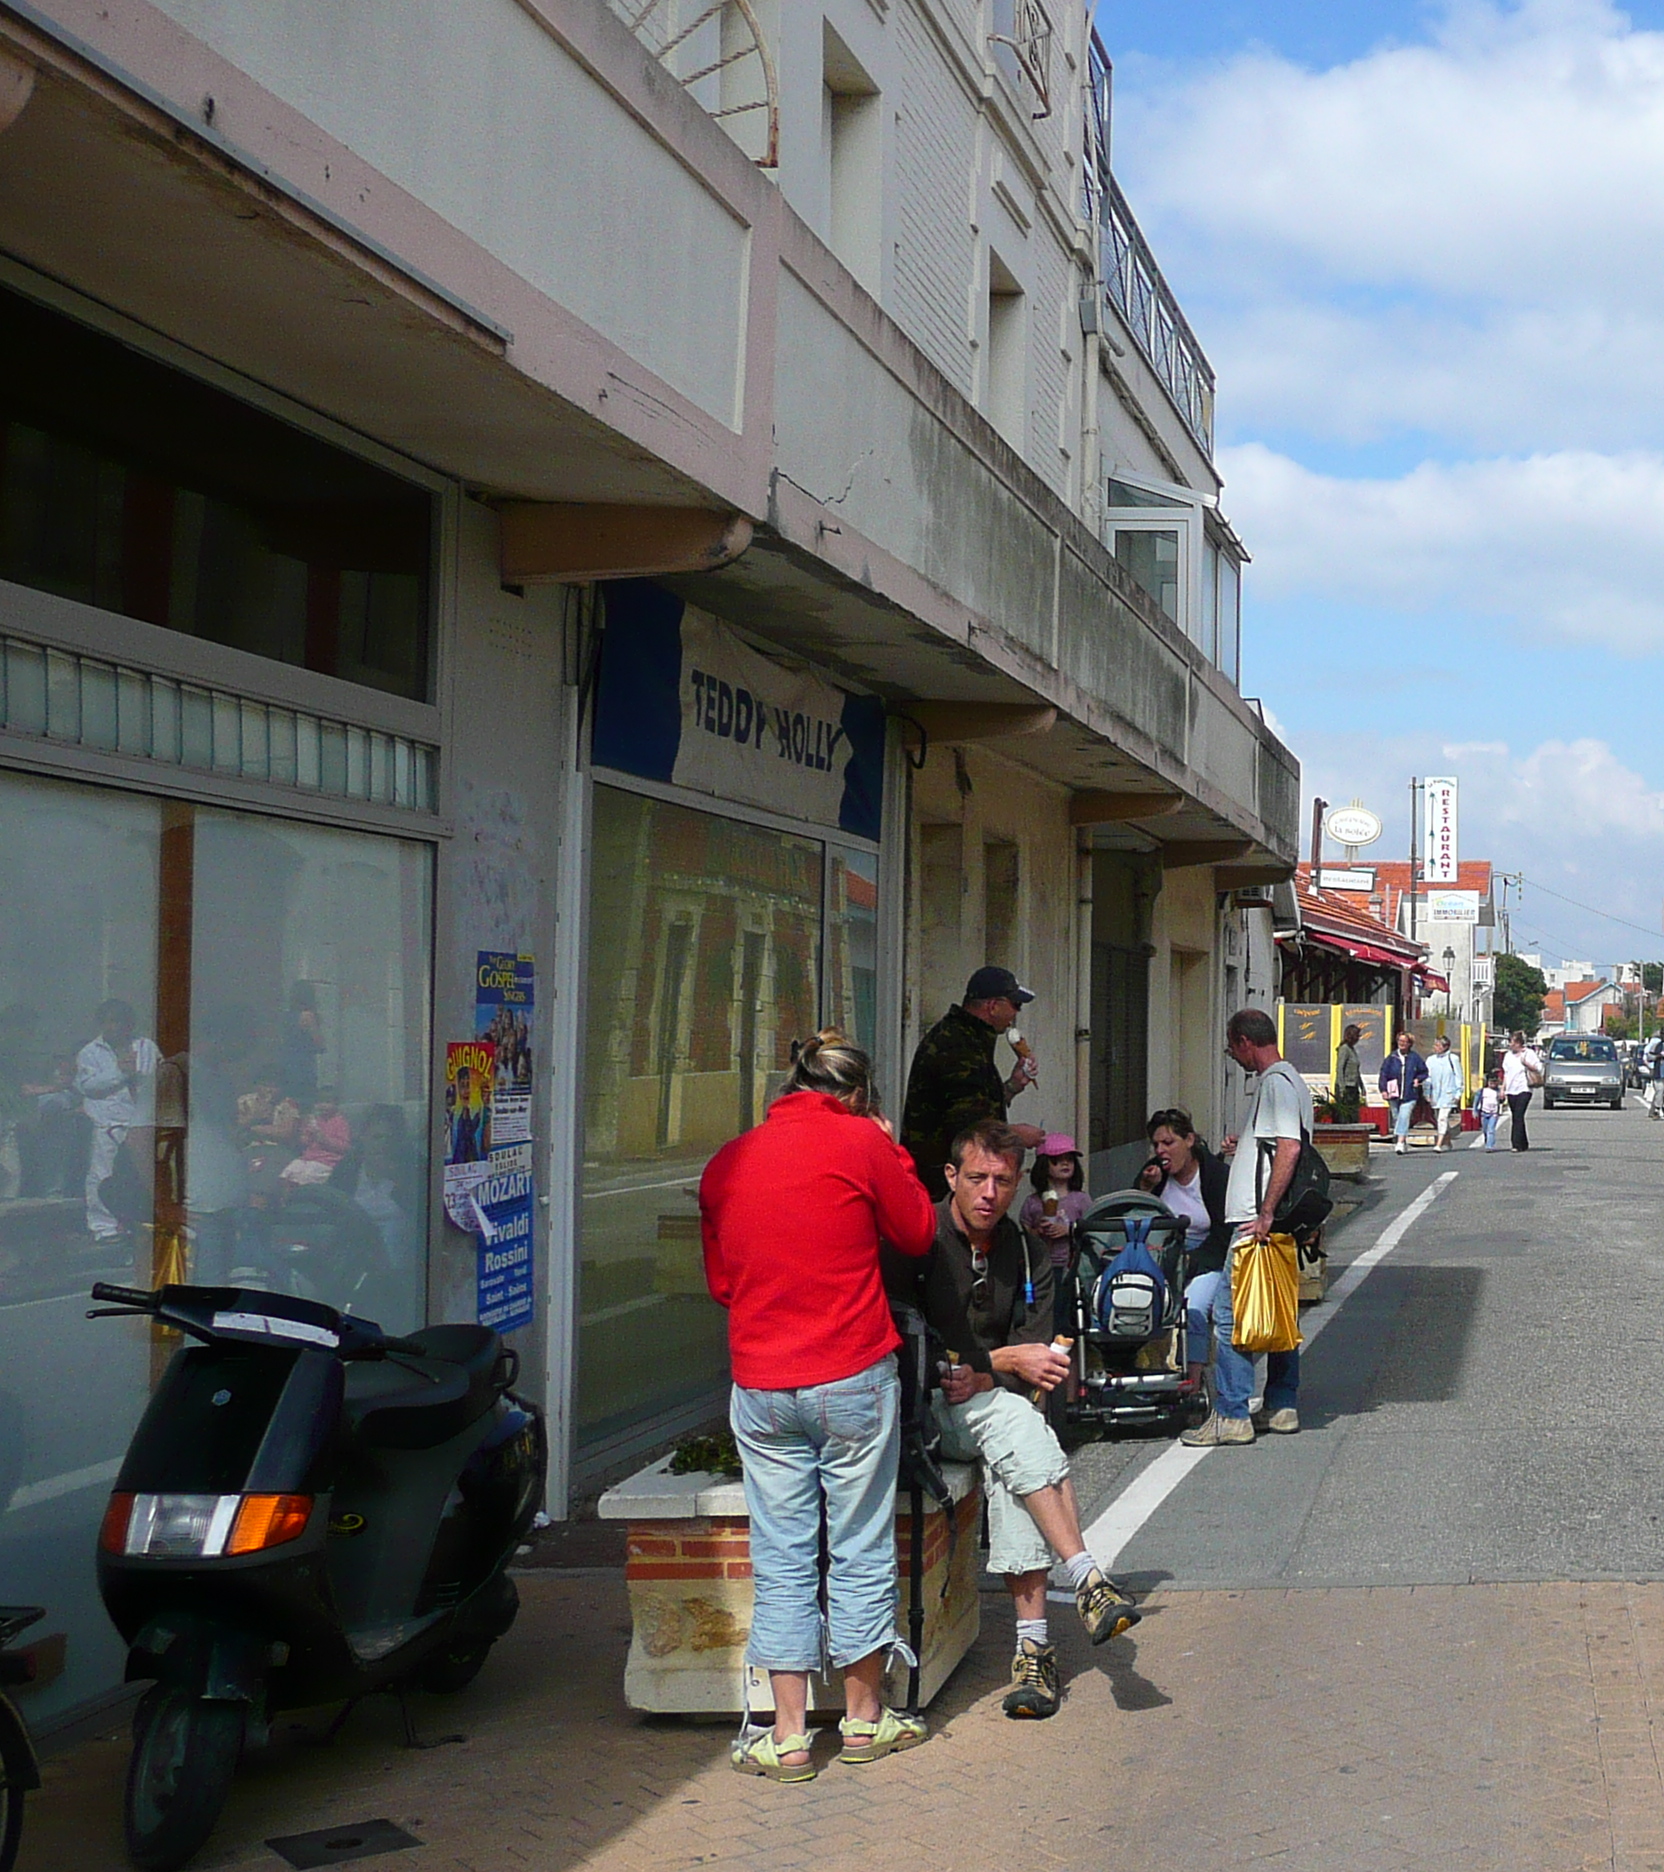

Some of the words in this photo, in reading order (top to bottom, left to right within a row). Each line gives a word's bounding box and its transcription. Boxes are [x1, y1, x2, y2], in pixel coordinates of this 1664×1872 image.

[691, 669, 767, 750] TEDDY
[774, 707, 844, 772] HOLLY
[1440, 789, 1451, 878] RESTAURANT
[446, 1045, 493, 1080] GUIGNOL
[488, 1146, 523, 1163] SOULAC
[478, 1172, 532, 1207] MOZART
[485, 1241, 528, 1273] Rossini
